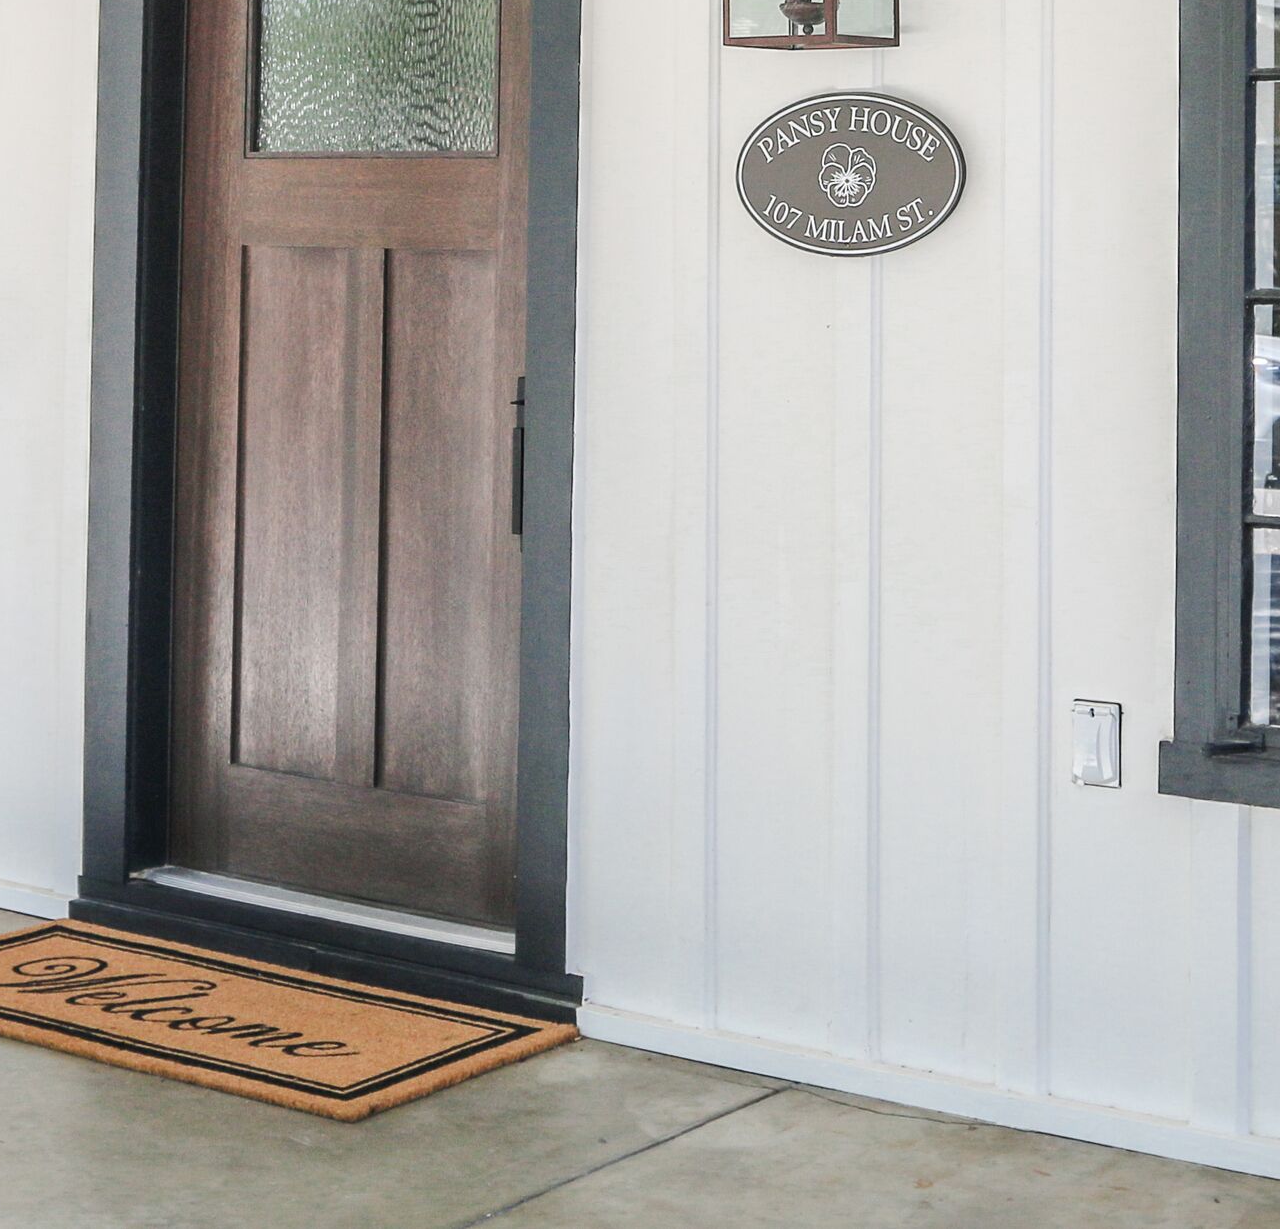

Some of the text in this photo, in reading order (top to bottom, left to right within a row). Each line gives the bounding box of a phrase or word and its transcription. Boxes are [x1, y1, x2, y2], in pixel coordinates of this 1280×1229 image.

[756, 106, 941, 164] PANSY HOUSE
[762, 194, 935, 244] 107 MILAM ST.
